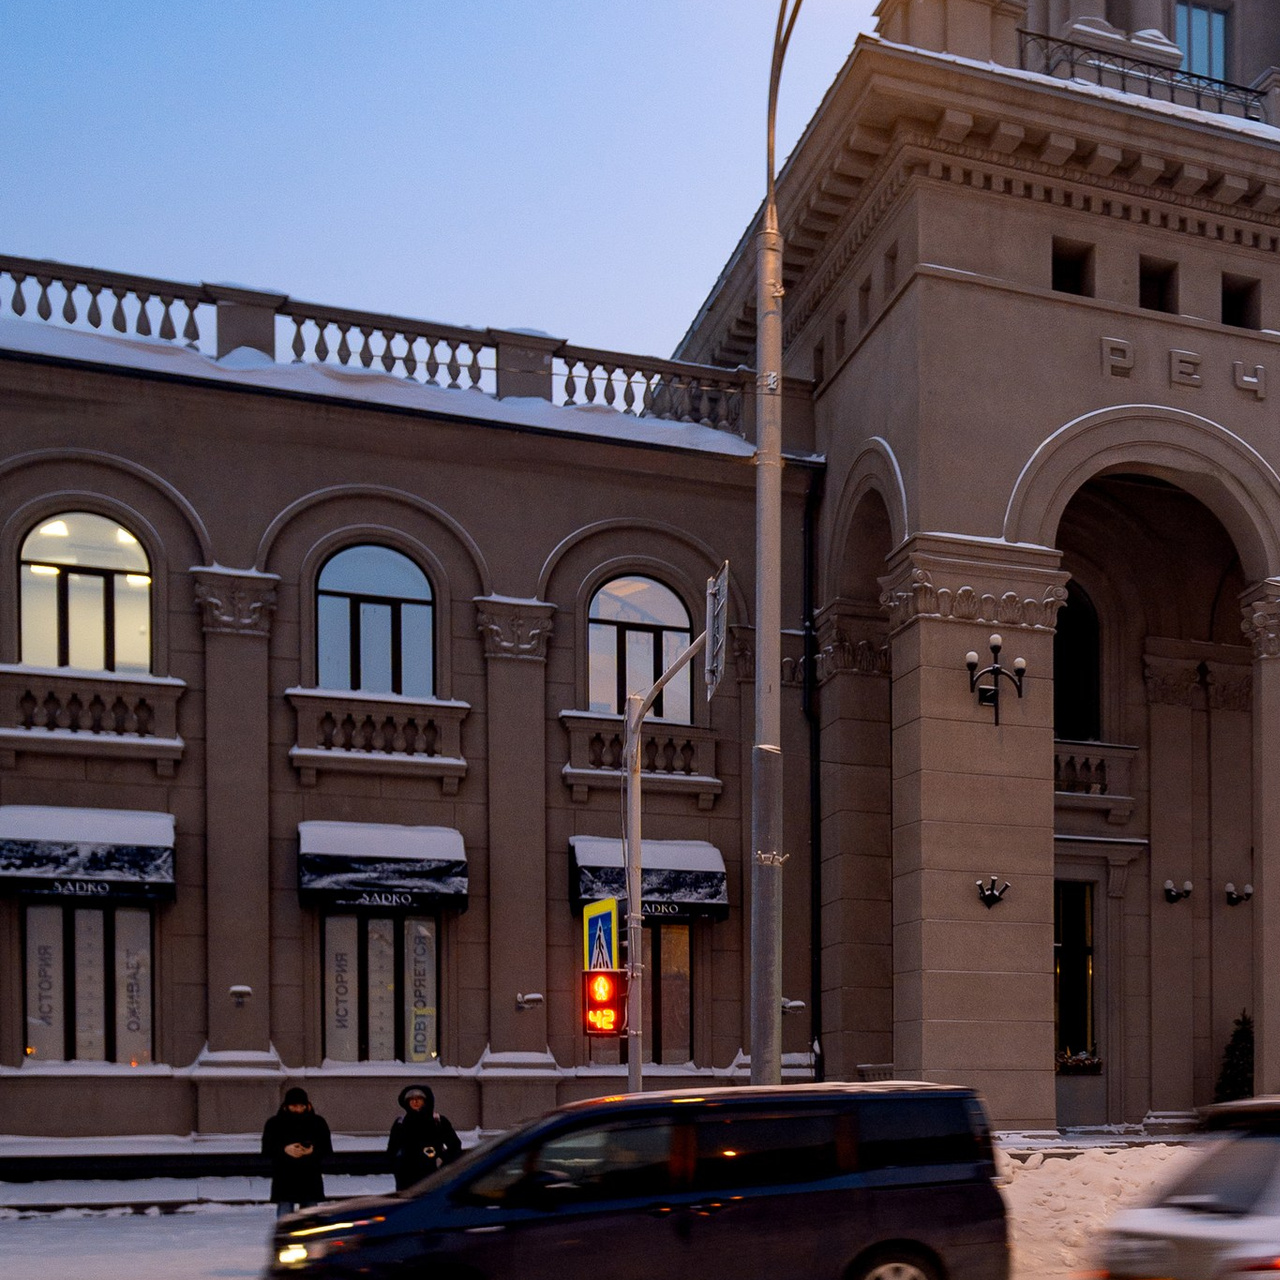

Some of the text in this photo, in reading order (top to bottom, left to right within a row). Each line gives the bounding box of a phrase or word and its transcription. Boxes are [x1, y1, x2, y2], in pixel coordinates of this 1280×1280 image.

[53, 881, 110, 895] SADKO
[362, 892, 412, 905] SADKO
[641, 903, 679, 913] ADKO
[335, 952, 349, 1029] ИСТОРИЯ
[588, 1009, 616, 1030] 42
